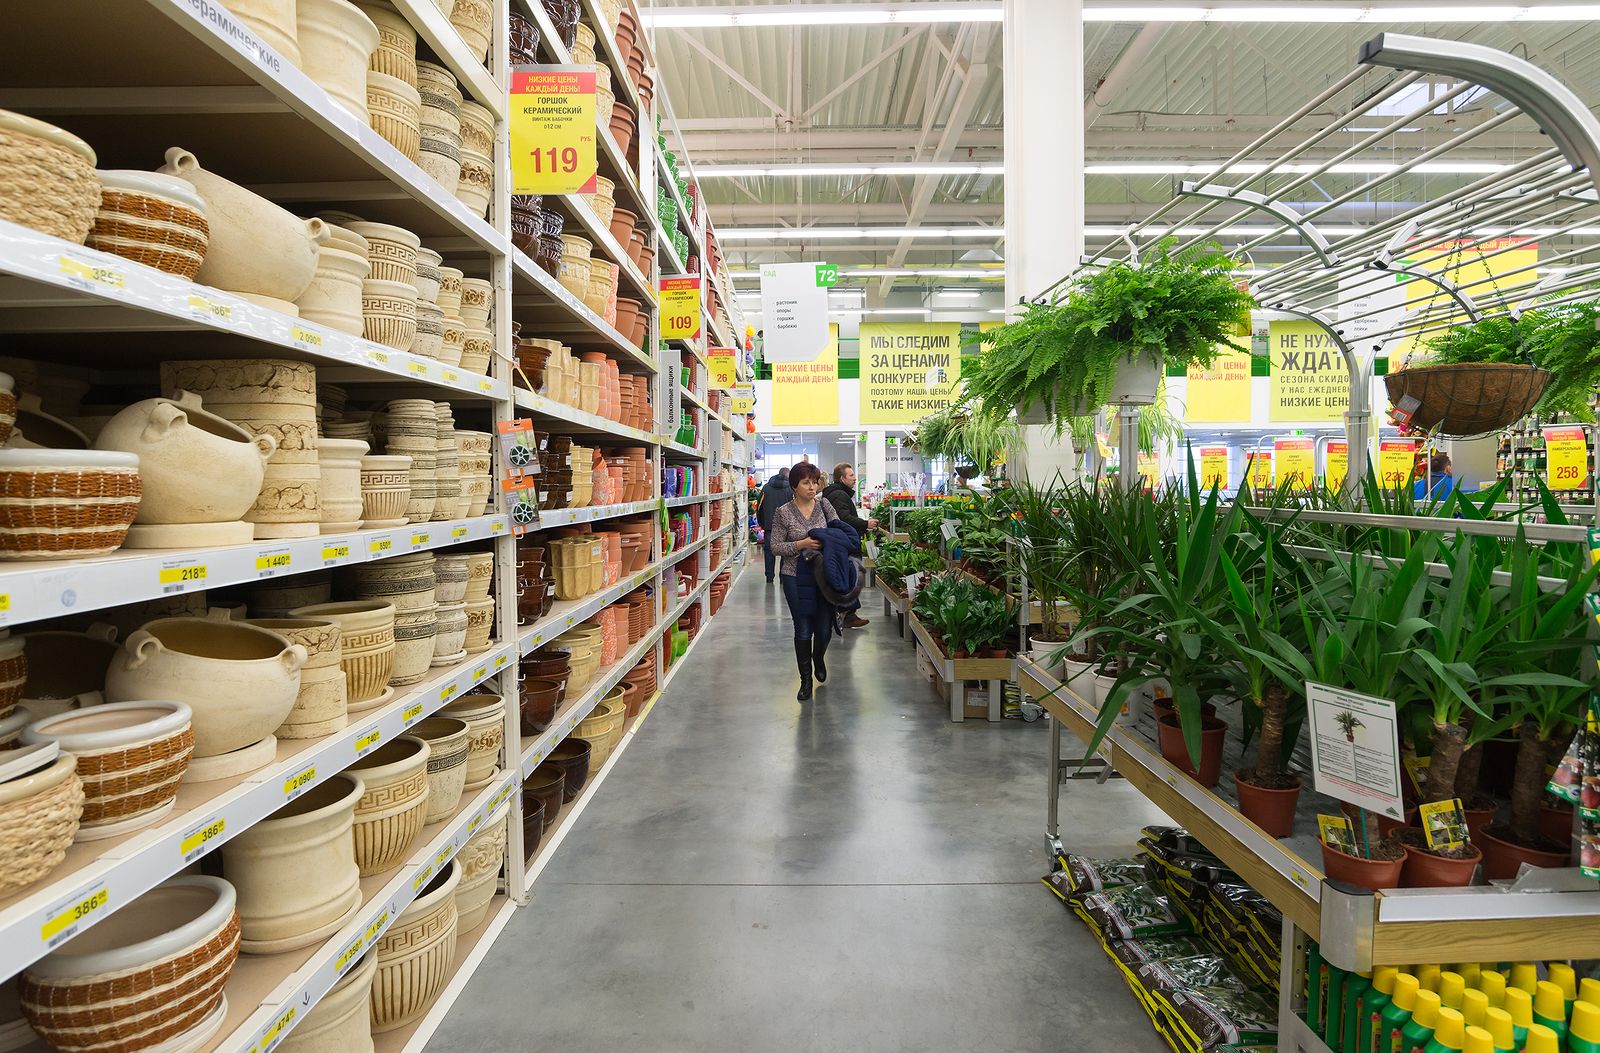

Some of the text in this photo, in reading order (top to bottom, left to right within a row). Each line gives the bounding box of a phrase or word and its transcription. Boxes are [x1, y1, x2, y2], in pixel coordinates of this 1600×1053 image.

[188, 0, 280, 73] ерамические
[558, 76, 578, 84] ЦЕНЫ
[526, 85, 580, 94] КАЖДЫЙ ДЕНЬ!
[523, 106, 582, 114] КЕРАМИЧЕСКИЙ
[530, 147, 578, 173] 119
[818, 269, 836, 282] 72
[669, 316, 692, 329] 109
[871, 336, 950, 350] МЫ СЛЕДИМ
[1281, 334, 1298, 348] НЕ
[871, 354, 950, 370] ЗА ЦЕНАМИ
[1223, 361, 1247, 370] ЦЕНЫ
[1281, 352, 1349, 373] ЖДАТ
[776, 364, 834, 373] НИЗКИЕ ЦЕНЫ
[717, 373, 728, 382] 26
[776, 374, 834, 384] КАЖДЫЙ ДЕНЬ!
[871, 373, 950, 384] КОНКУРЕНВ,
[1225, 373, 1246, 381] ДЕНЬ!
[1280, 375, 1315, 383] СЕЗОНА
[871, 400, 904, 409] ТАКИЕ
[1280, 397, 1321, 406] НИЗКИЕ
[1385, 471, 1405, 482] 236
[1557, 466, 1579, 479] 258
[334, 548, 345, 556] 740
[272, 556, 286, 566] 440
[182, 568, 199, 580] 218
[202, 824, 219, 842] 386
[74, 896, 98, 920] 386
[277, 1013, 290, 1031] 474
